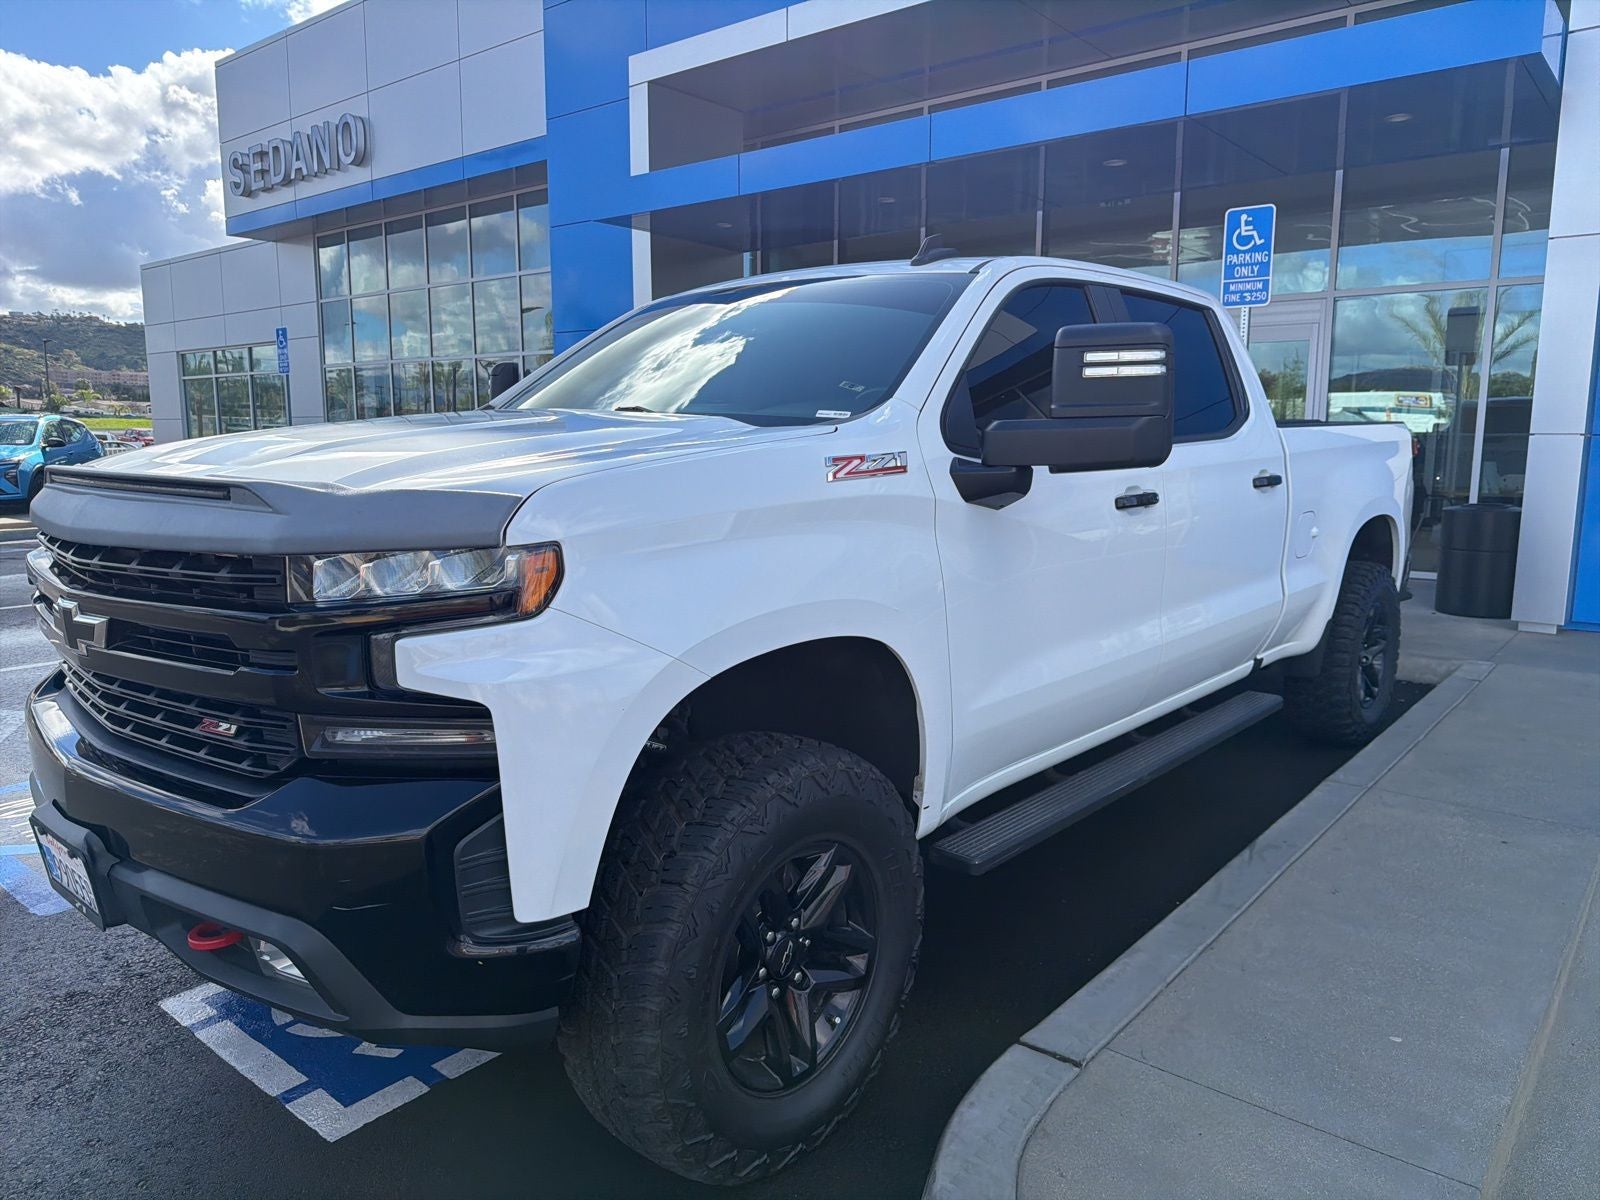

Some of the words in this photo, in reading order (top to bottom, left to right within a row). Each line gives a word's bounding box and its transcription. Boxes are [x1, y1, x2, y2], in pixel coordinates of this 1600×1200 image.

[229, 112, 366, 197] SEDANO
[1226, 251, 1269, 266] PARKING
[1234, 264, 1260, 278] ONLY
[1229, 281, 1263, 292] MINIMUM
[1224, 293, 1242, 303] FINE
[824, 451, 908, 483] Z71
[199, 718, 238, 737] Z71
